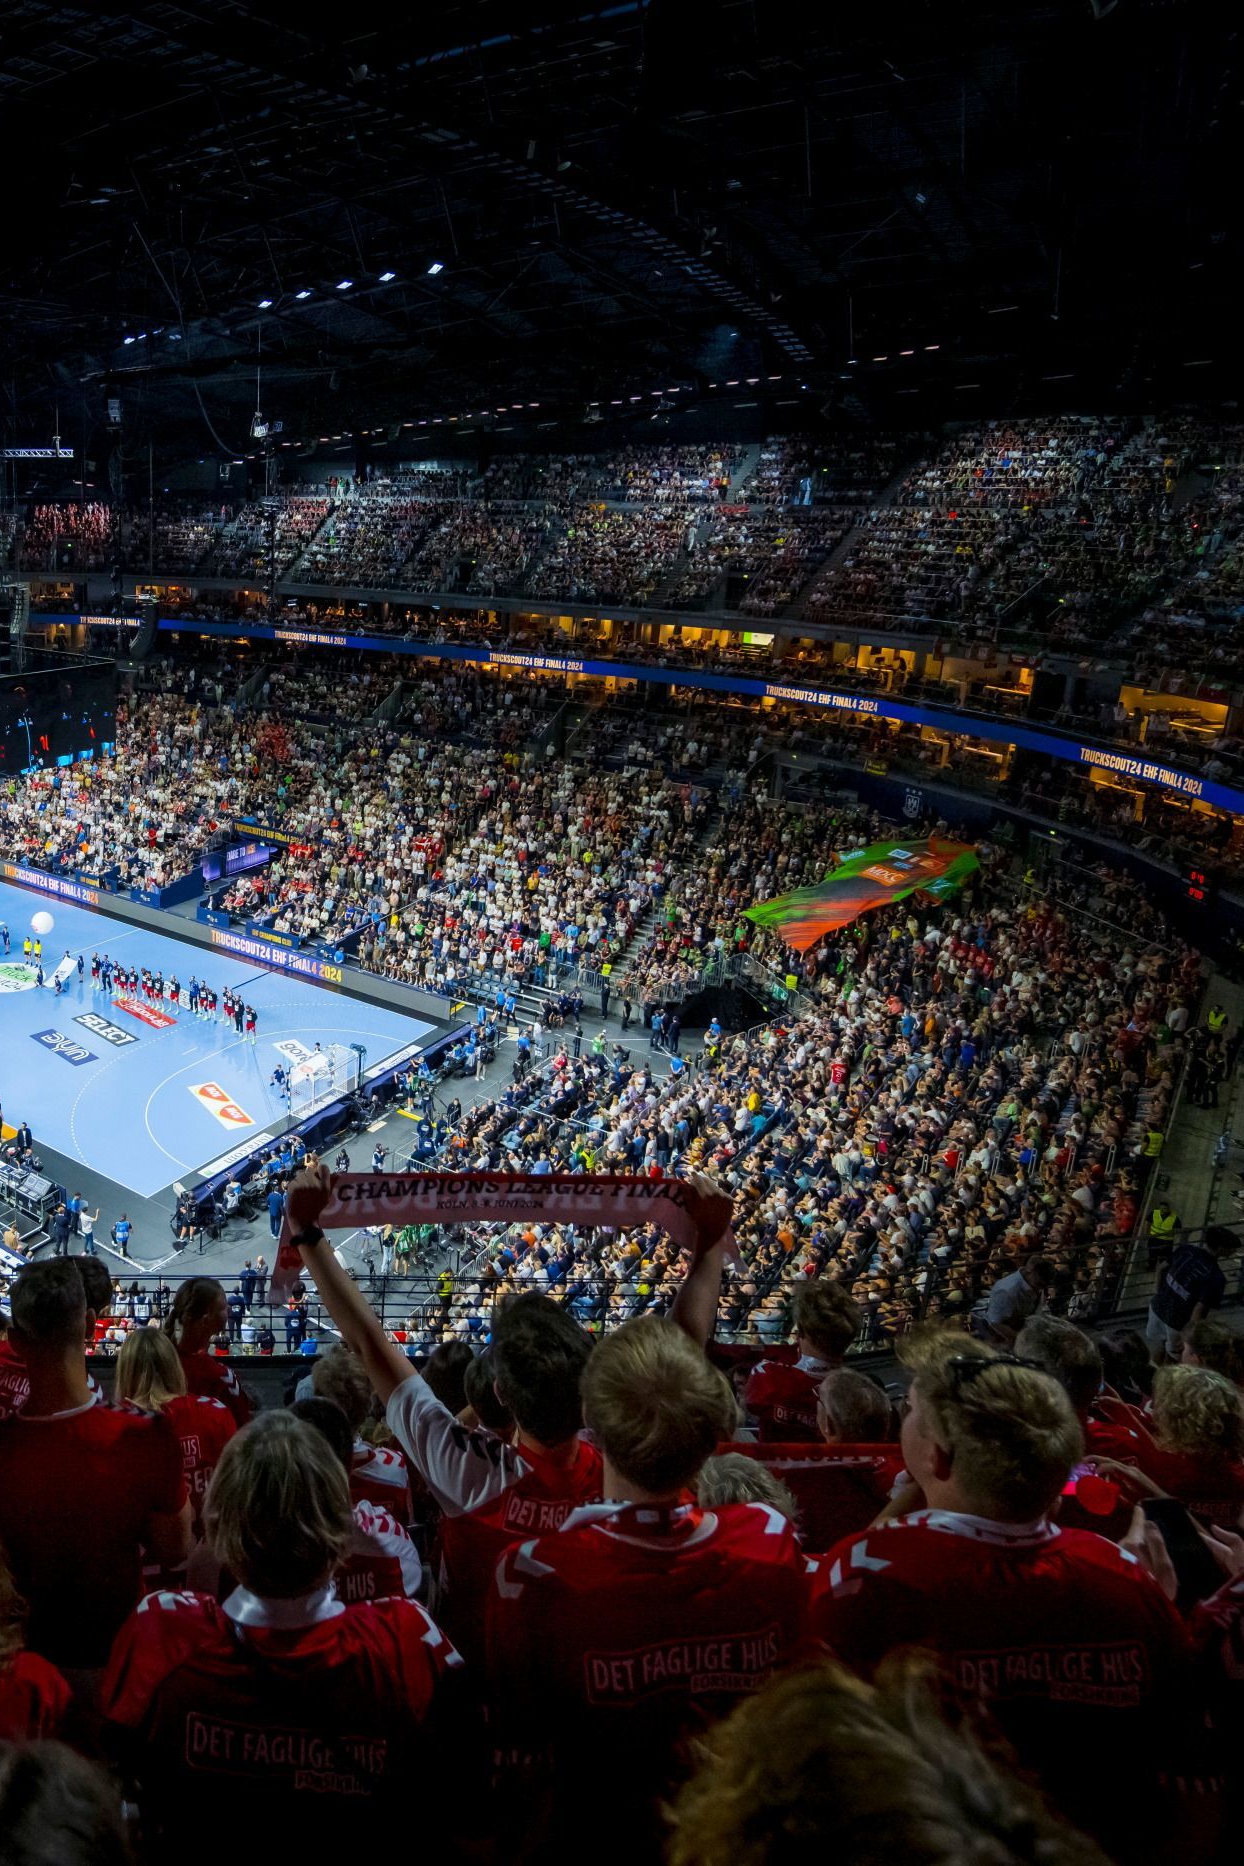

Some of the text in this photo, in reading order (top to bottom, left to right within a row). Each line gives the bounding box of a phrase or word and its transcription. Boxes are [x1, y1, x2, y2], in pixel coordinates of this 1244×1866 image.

[489, 652, 583, 671] TRUCKSCOUT24 EHF FINAL4 2024
[766, 684, 878, 712] TRUCKSCOUT24 EHF FINAL4 2024
[1080, 747, 1203, 796] TRUCKSCOUT24 EHF FINAL4 2024
[3, 863, 47, 888] TRUCKSCOUT24
[48, 878, 59, 892] EHF
[60, 881, 81, 899] FINAL4
[82, 888, 99, 904] 2024
[866, 864, 905, 884] MDCC
[211, 929, 342, 983] TRUCKSCOUT24 EHF FINAL4 2024
[76, 1013, 136, 1045] SELECT
[337, 1178, 500, 1202] CHAMPIONS
[505, 1181, 605, 1195] LEAGUE
[182, 1438, 197, 1456] US
[508, 1497, 537, 1528] DET
[346, 1570, 377, 1599] HUS
[592, 1630, 779, 1693] DET FAGLIGE HUS
[960, 1657, 999, 1691] DET
[1100, 1648, 1144, 1682] HUS
[192, 1720, 235, 1760] DET
[242, 1731, 336, 1769] FAGLIGE
